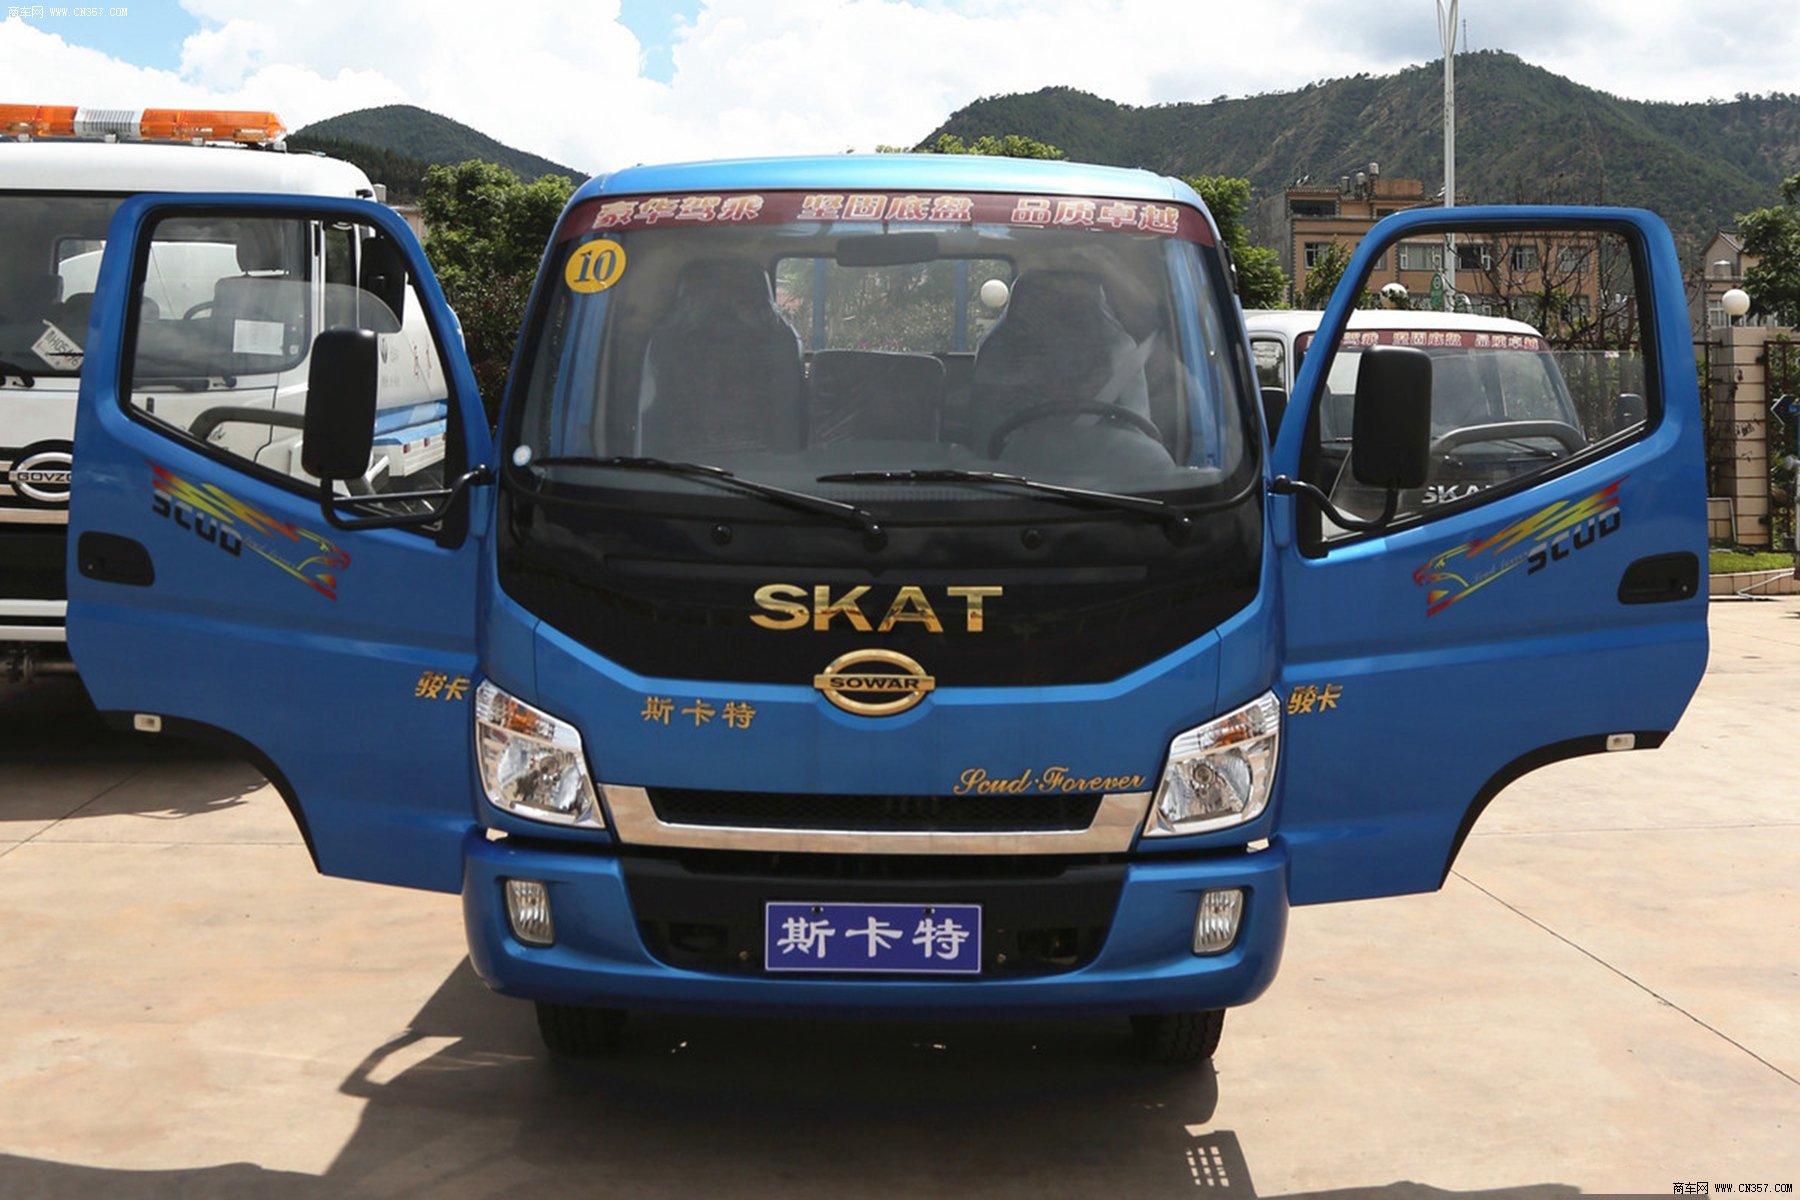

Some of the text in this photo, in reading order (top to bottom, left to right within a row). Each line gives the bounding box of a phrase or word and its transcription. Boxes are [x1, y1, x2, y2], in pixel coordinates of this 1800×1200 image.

[592, 194, 1180, 234] 豪华驾乘 坚固底盘 品质卓越
[574, 249, 617, 283] 10
[1422, 484, 1493, 504] SKA
[152, 488, 243, 558] SCUD
[1526, 505, 1621, 576] SCUD
[750, 583, 1003, 633] SKAT
[415, 671, 470, 701] 骏卡
[829, 676, 921, 690] SOWAR
[1288, 684, 1343, 715] 骏卡
[641, 696, 757, 729] 斯卡特
[776, 915, 970, 960] 斯卡特
